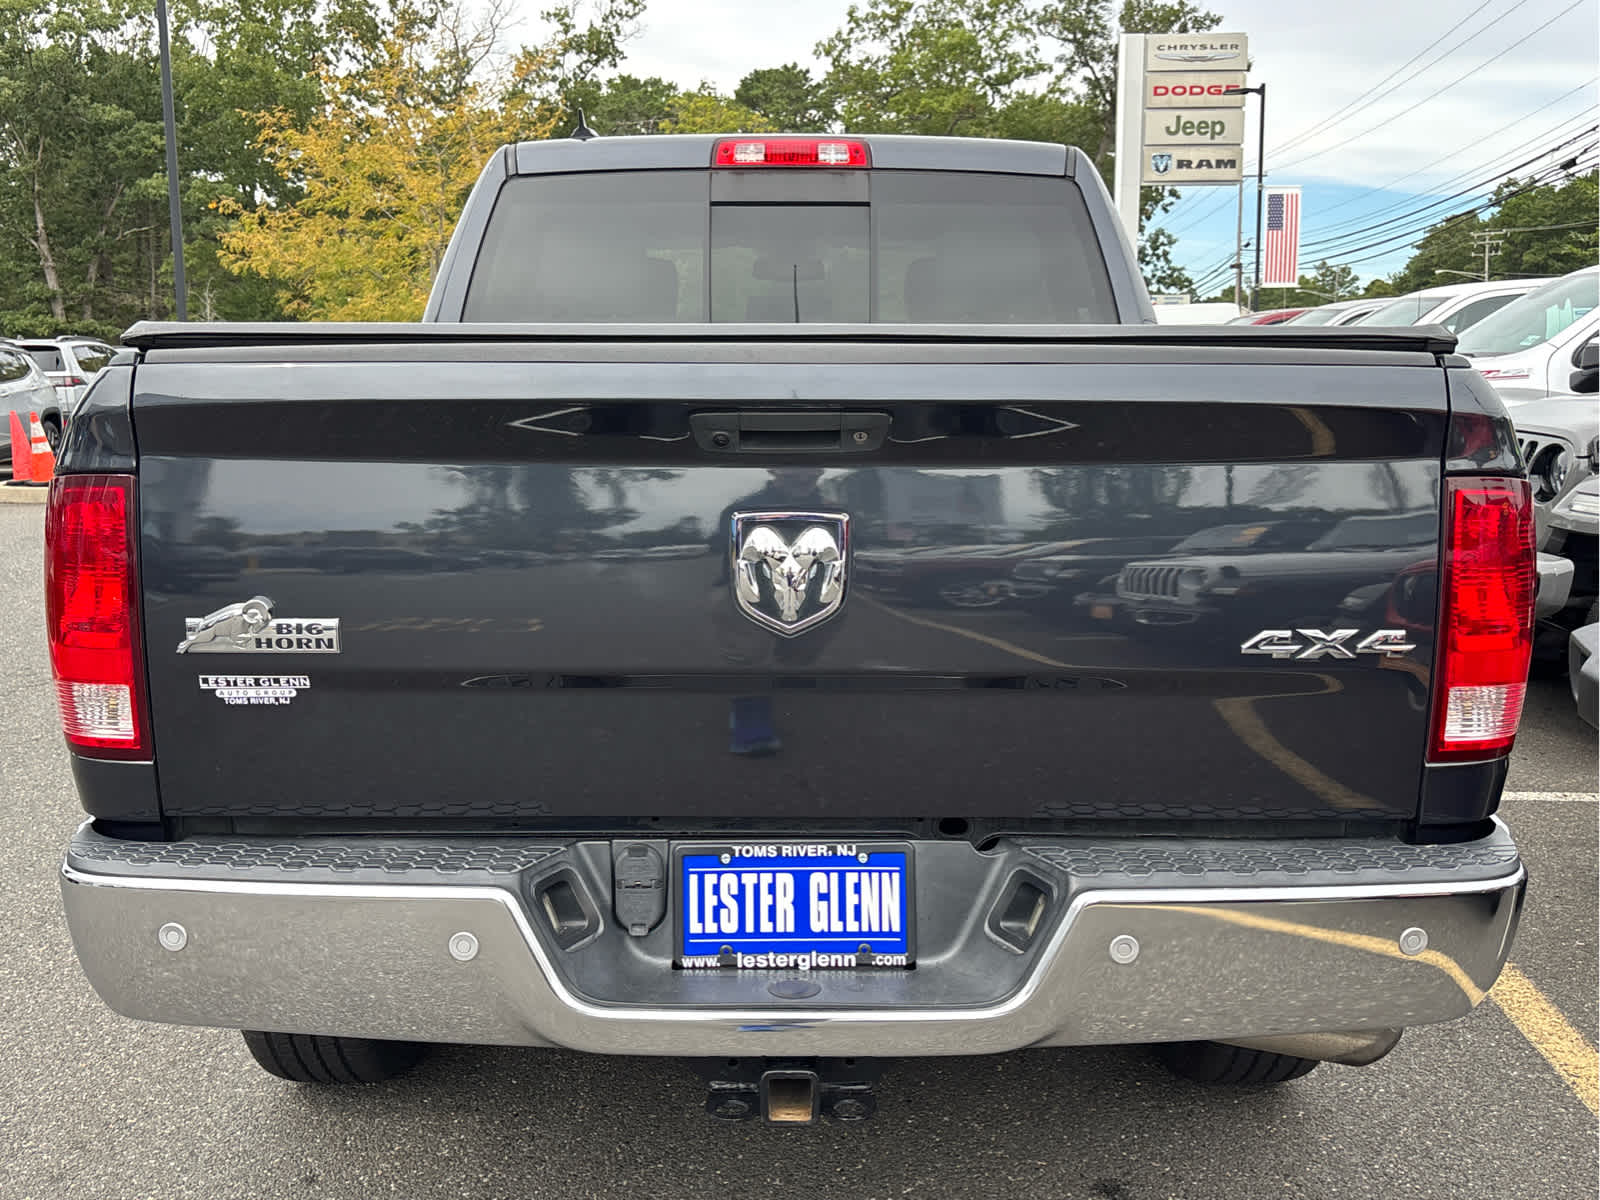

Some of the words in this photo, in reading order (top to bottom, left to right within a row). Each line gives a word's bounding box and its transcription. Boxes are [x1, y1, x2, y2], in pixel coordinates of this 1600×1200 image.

[1157, 43, 1240, 51] CHRYSLER
[1165, 115, 1225, 140] Jeep
[1176, 159, 1236, 169] RAM
[275, 623, 324, 635] BIG
[255, 638, 334, 649] HORN
[199, 677, 255, 687] LESTER
[260, 677, 310, 687] GLENN
[250, 698, 278, 706] RIVER,
[733, 846, 777, 857] TOMS
[782, 845, 833, 857] RIVER,
[837, 845, 857, 856] NJ
[689, 873, 795, 934] LESTER
[809, 872, 900, 933] GLENN
[681, 957, 721, 968] www.
[737, 951, 857, 970] lesterglenn
[871, 954, 907, 966] .com
